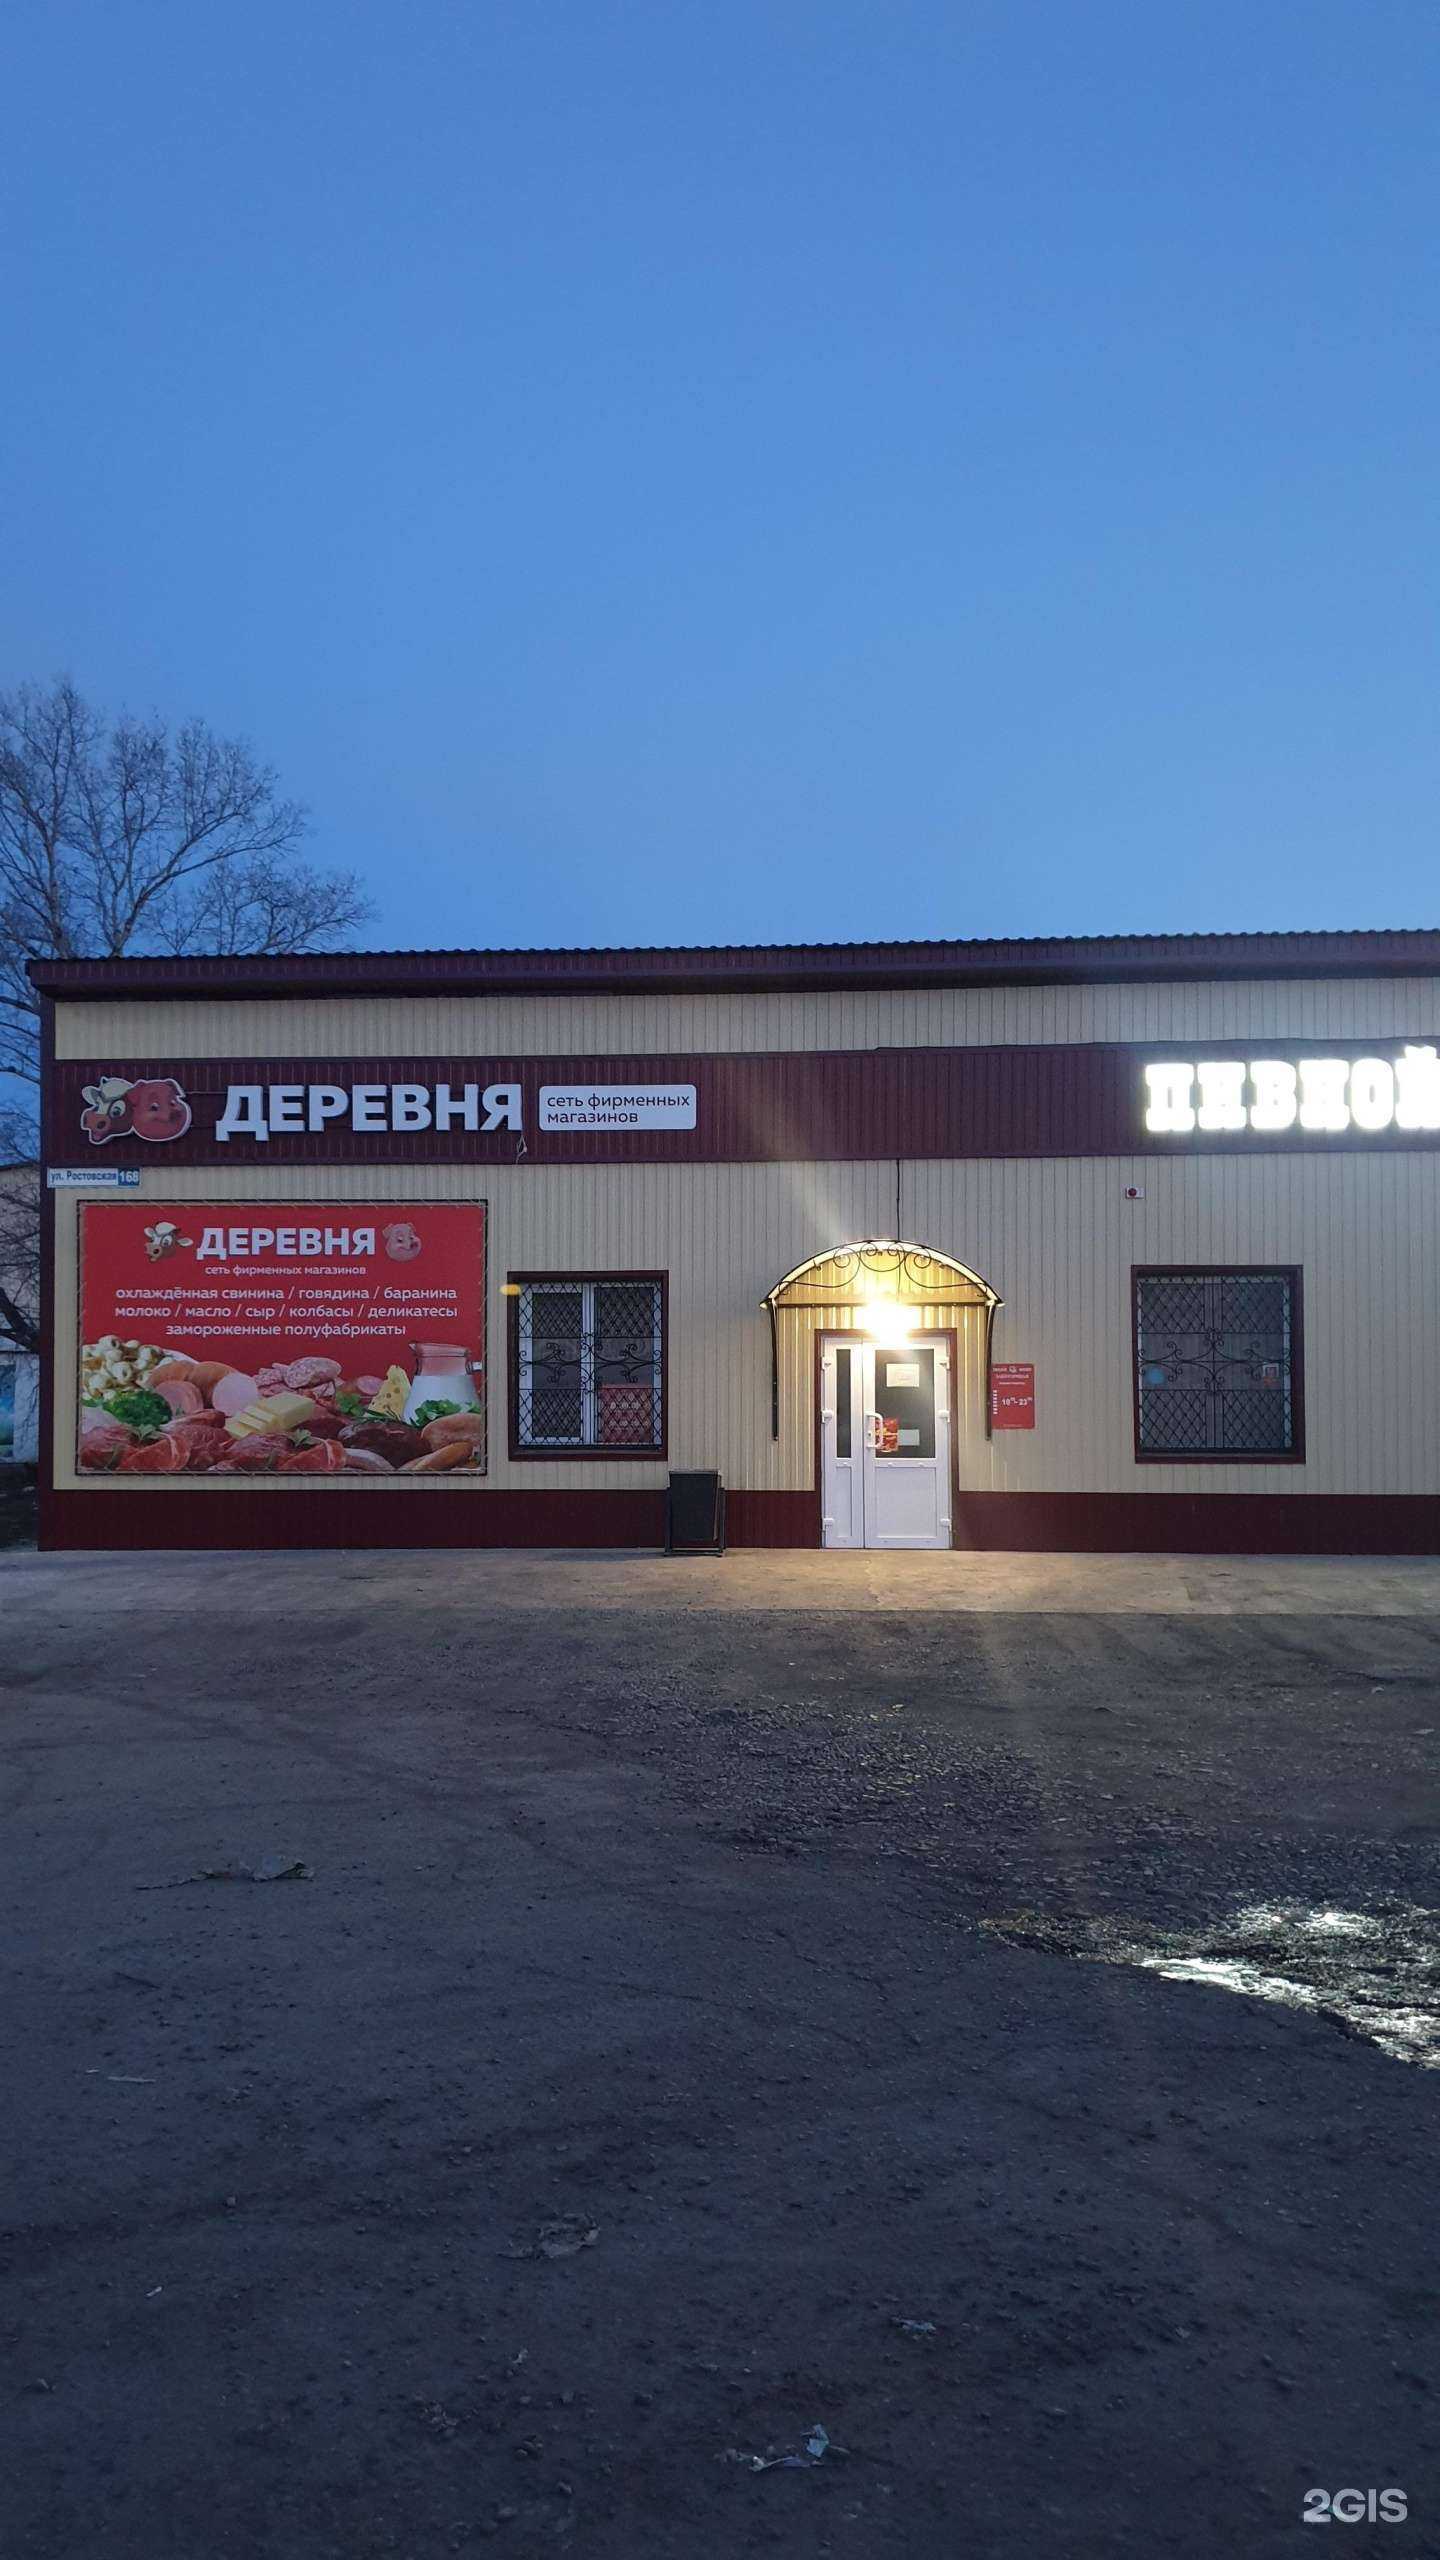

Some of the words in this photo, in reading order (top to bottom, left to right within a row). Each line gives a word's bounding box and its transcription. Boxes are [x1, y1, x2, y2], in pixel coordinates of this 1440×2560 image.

[546, 1096, 583, 1108] сеть
[587, 1092, 690, 1112] фирменных
[215, 1084, 522, 1141] ДЕРЕВНЯ
[547, 1111, 639, 1124] магазинов
[66, 1170, 117, 1181] Ростовская
[196, 1228, 376, 1260] ДЕРЕВНЯ
[205, 1267, 231, 1275] сеть
[233, 1264, 302, 1277] фирменных
[304, 1266, 367, 1275] магазинов
[115, 1286, 218, 1300] охлаждённая
[221, 1289, 285, 1299] свинина
[298, 1289, 370, 1301] говядина
[383, 1287, 458, 1301] баранина
[114, 1307, 172, 1317] молоко
[185, 1307, 232, 1317] масло
[245, 1307, 276, 1320] сыр
[289, 1304, 354, 1317] колбасы
[368, 1307, 458, 1319] деликатесы
[165, 1325, 282, 1338] замороженные
[284, 1323, 406, 1339] полуфабрикаты
